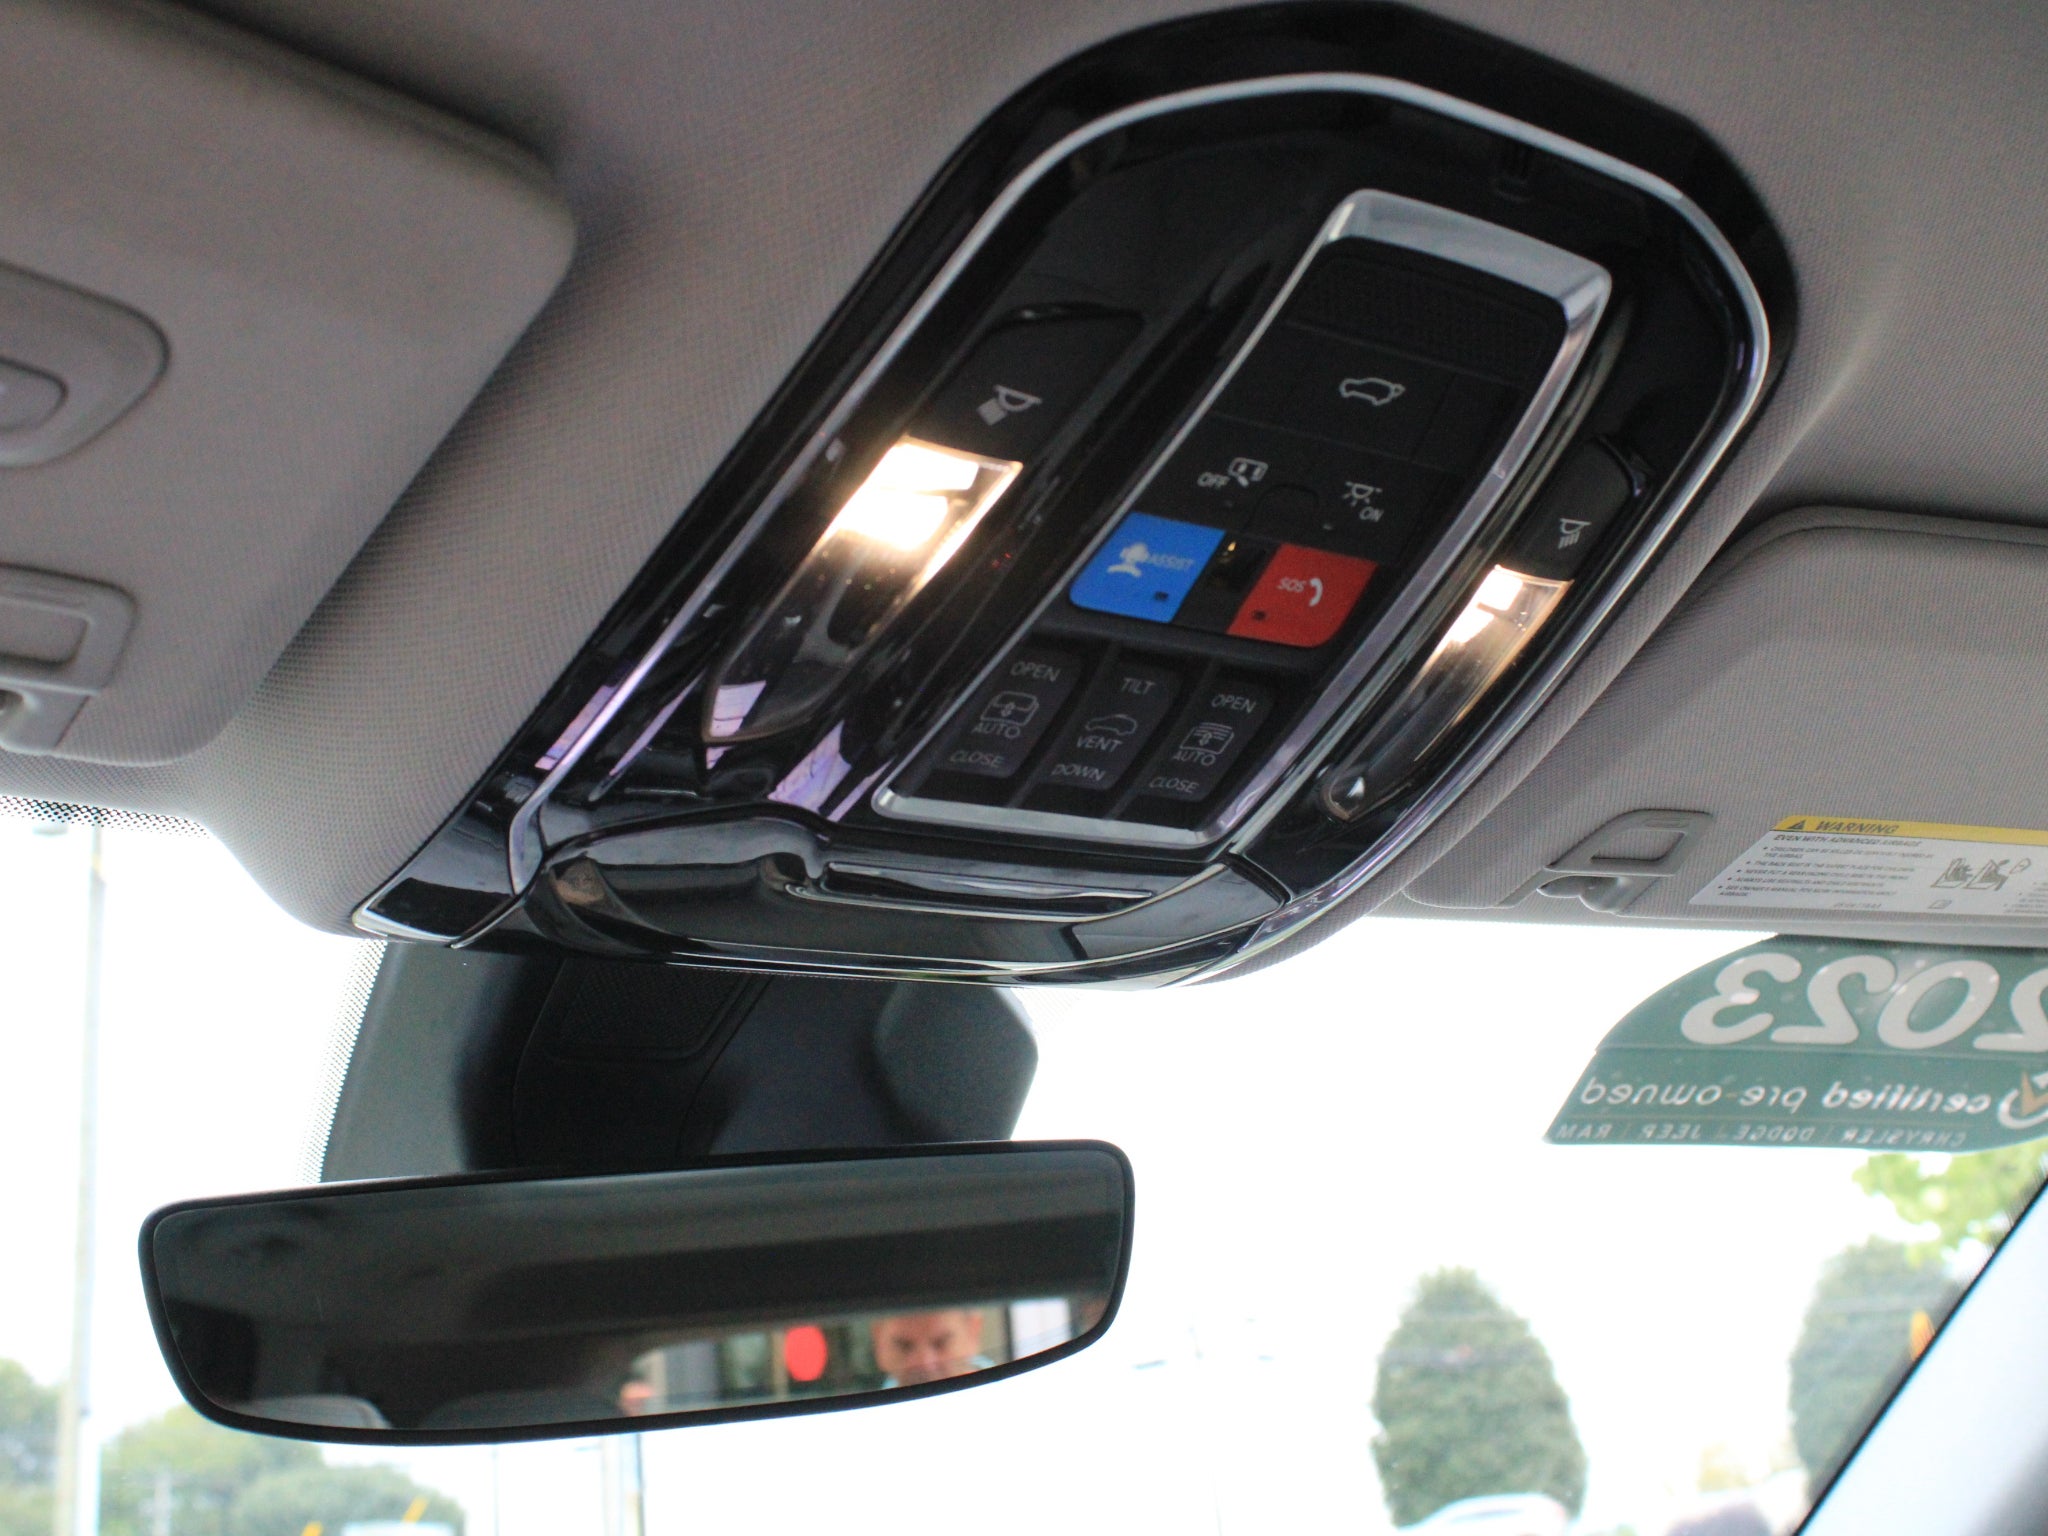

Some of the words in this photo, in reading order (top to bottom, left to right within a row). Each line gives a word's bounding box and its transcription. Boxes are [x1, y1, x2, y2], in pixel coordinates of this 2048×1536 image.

[1197, 471, 1230, 489] OFF
[1358, 506, 1385, 523] ON
[1276, 577, 1308, 594] SOS
[1010, 661, 1061, 682] OPEN
[1120, 676, 1156, 696] TILT
[1210, 693, 1257, 714] OPEN
[971, 721, 1022, 740] AUTO
[1076, 735, 1123, 753] VENT
[949, 749, 1005, 769] CLOSE
[1172, 749, 1216, 767] AUTO
[1051, 763, 1106, 782] DOWN
[1148, 775, 1200, 795] CLOSE
[1814, 820, 1901, 835] WARNING
